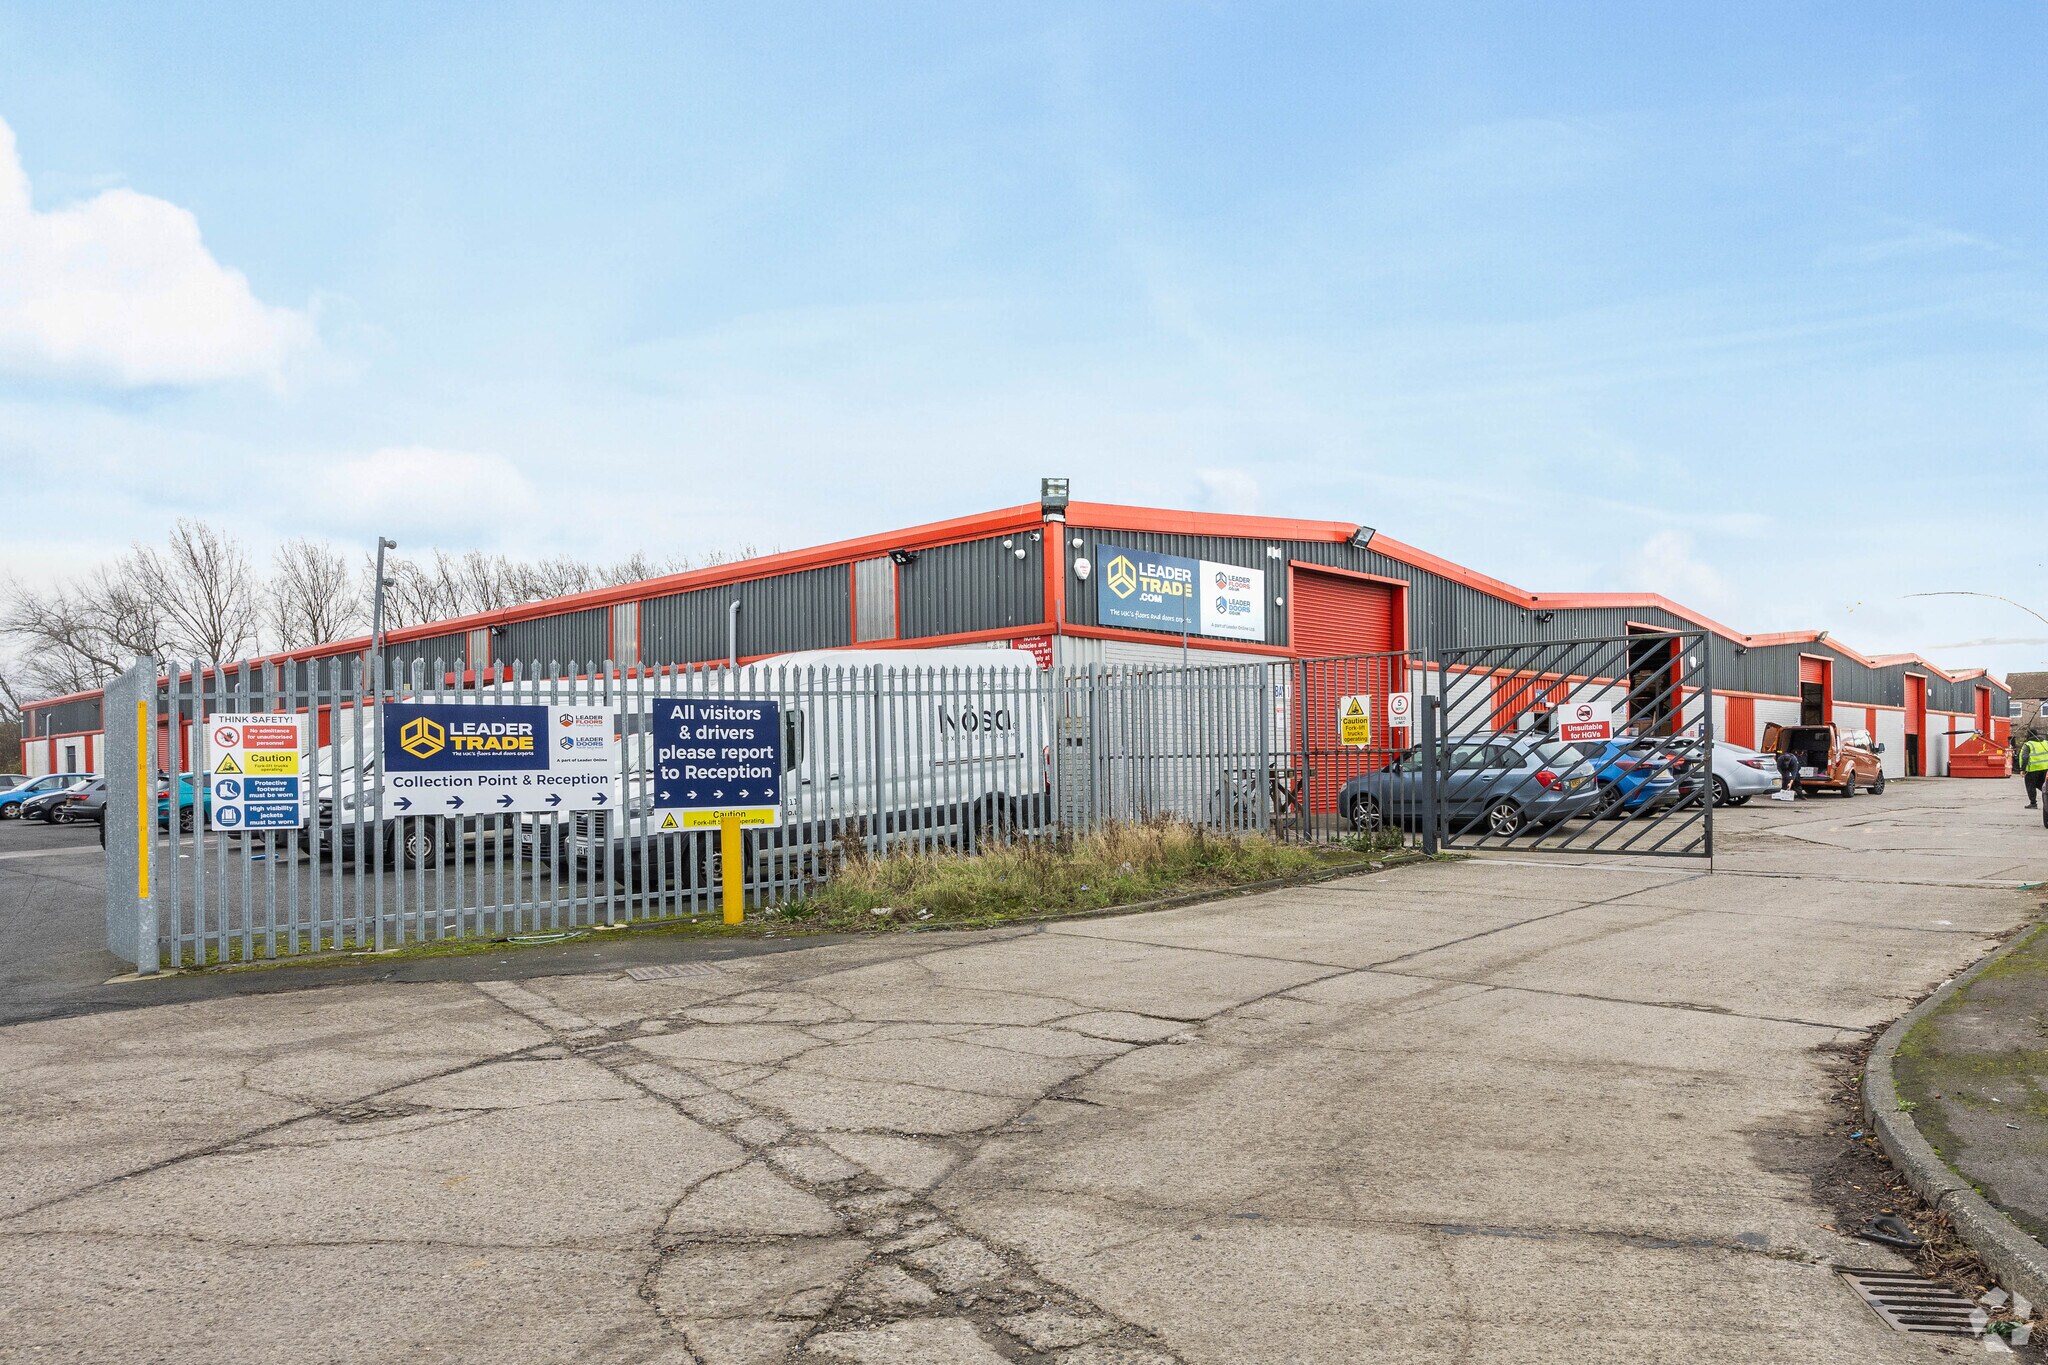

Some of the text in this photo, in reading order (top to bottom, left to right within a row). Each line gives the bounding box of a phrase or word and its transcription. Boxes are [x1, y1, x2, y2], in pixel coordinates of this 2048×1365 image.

[1139, 562, 1192, 582] LEADER
[1228, 574, 1250, 584] LEADER
[1139, 576, 1193, 598] TRADE
[1228, 581, 1250, 590] FLOORS
[1139, 592, 1162, 603] .COM
[1228, 598, 1251, 607] LEADER
[1228, 604, 1251, 613] DOORS
[1135, 610, 1149, 619] floors
[1150, 612, 1161, 620] and
[1162, 613, 1174, 622] doors
[1175, 616, 1192, 624] expts
[670, 705, 761, 720] All visitors
[450, 722, 533, 736] LEADER
[679, 725, 754, 740] & drivers
[1567, 723, 1603, 732] Unsuitable
[1581, 731, 1601, 739] HGVs
[450, 736, 534, 750] TRADE
[251, 754, 292, 762] Caution
[659, 745, 774, 763] please report
[661, 764, 772, 782] to Reception
[393, 773, 608, 788] Collection Point & Reception
[713, 811, 746, 819] Caution
